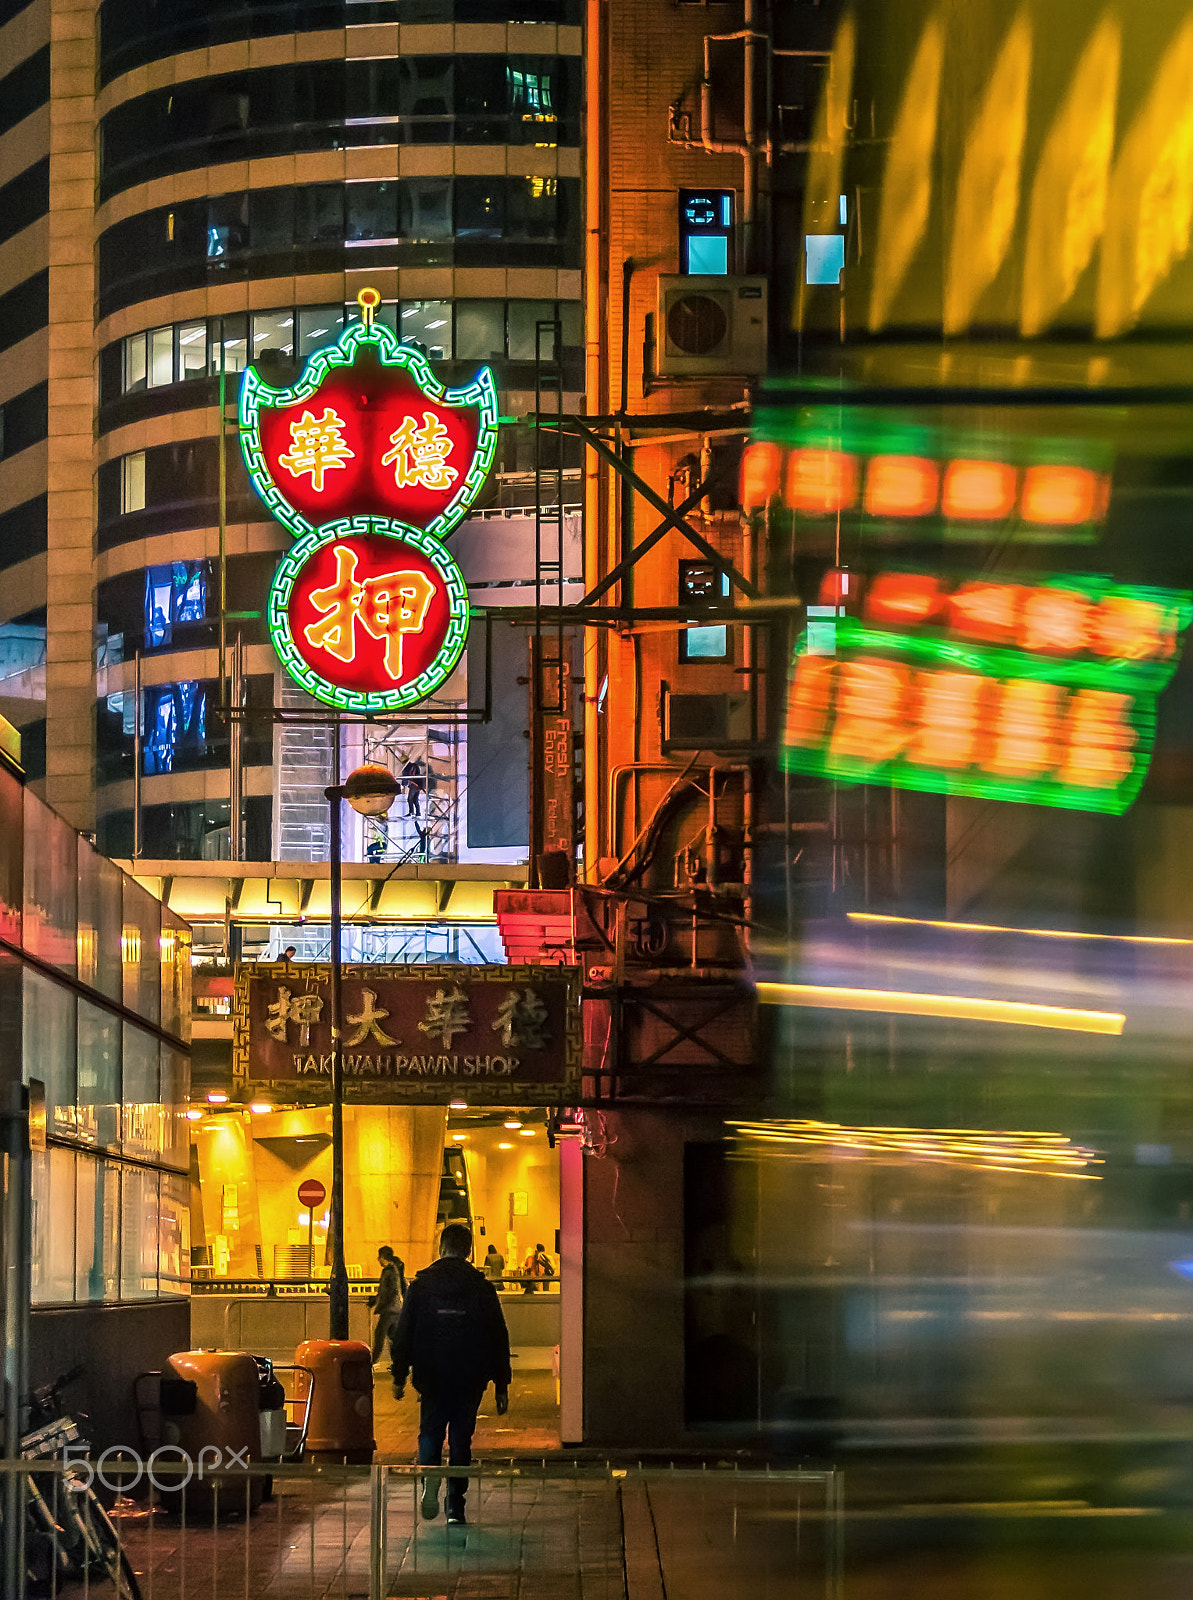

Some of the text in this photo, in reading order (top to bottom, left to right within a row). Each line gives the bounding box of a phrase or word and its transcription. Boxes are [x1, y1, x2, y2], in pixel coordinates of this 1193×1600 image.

[304, 545, 437, 680] 押
[545, 730, 556, 774] Enjoy
[557, 719, 570, 777] Fresh
[293, 1054, 520, 1076] TAK WAH PAWN SHOP
